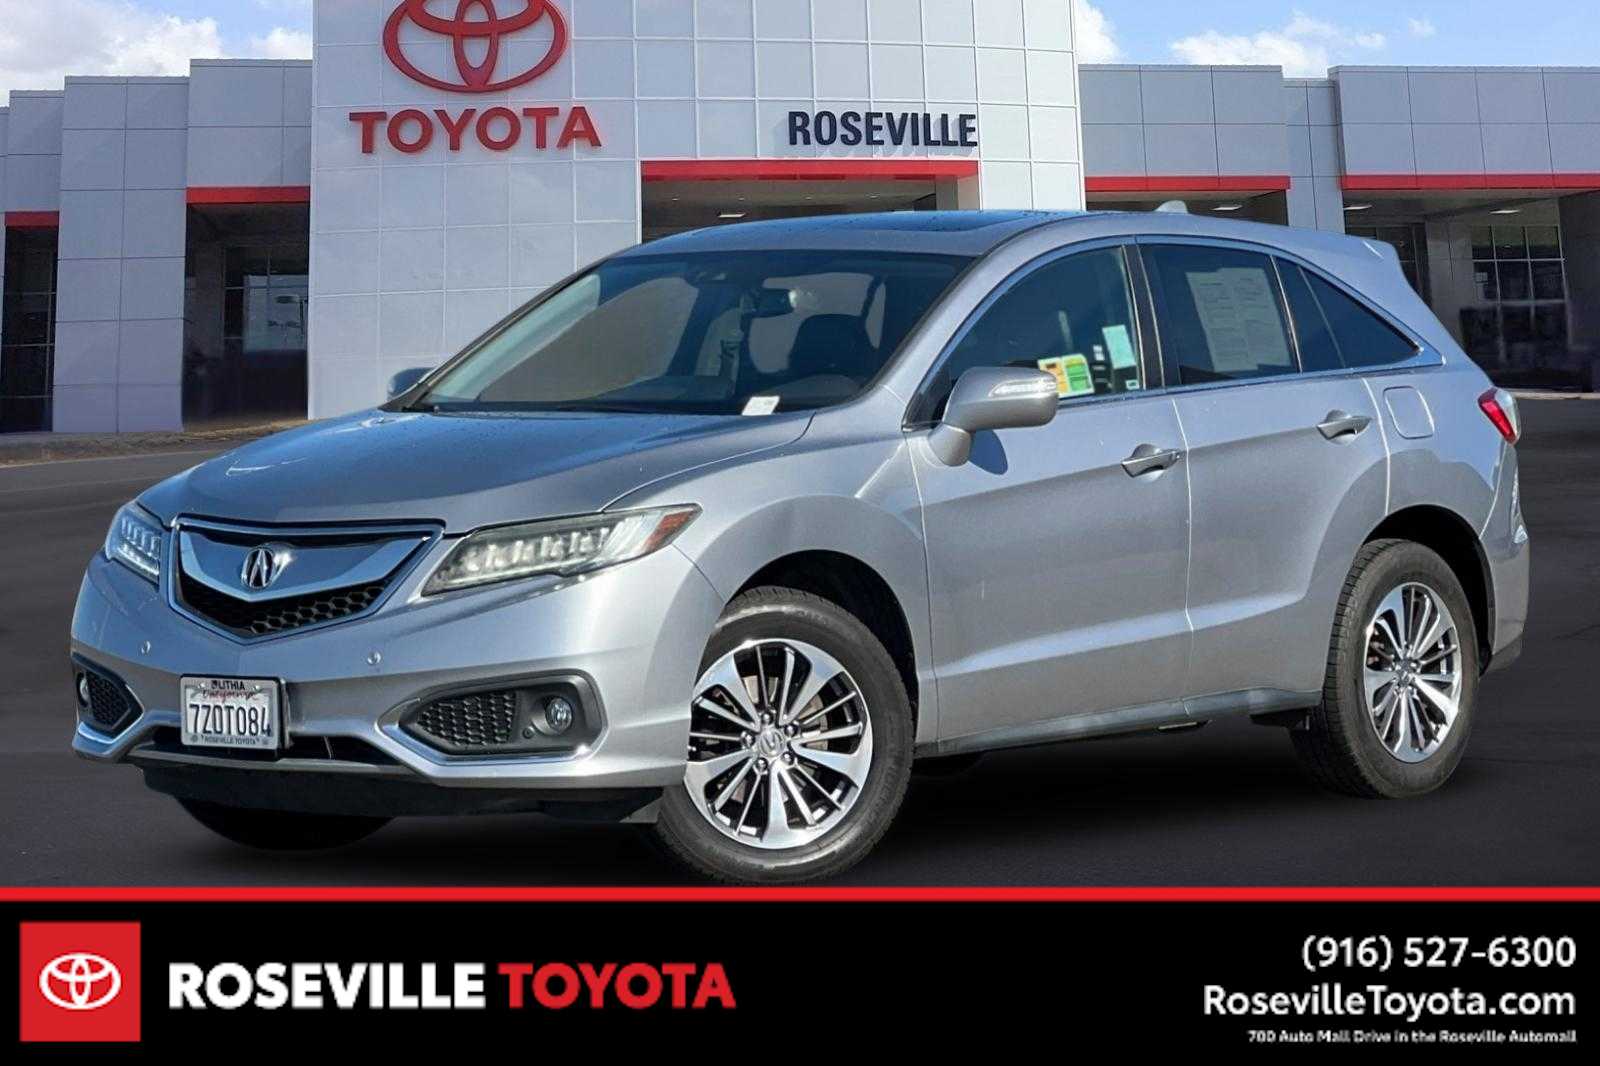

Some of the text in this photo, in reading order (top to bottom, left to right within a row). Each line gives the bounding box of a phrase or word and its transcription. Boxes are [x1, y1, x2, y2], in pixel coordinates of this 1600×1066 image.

[349, 106, 602, 154] TOYOTA
[788, 110, 978, 147] ROSEVILLE
[218, 680, 246, 690] LITHIA
